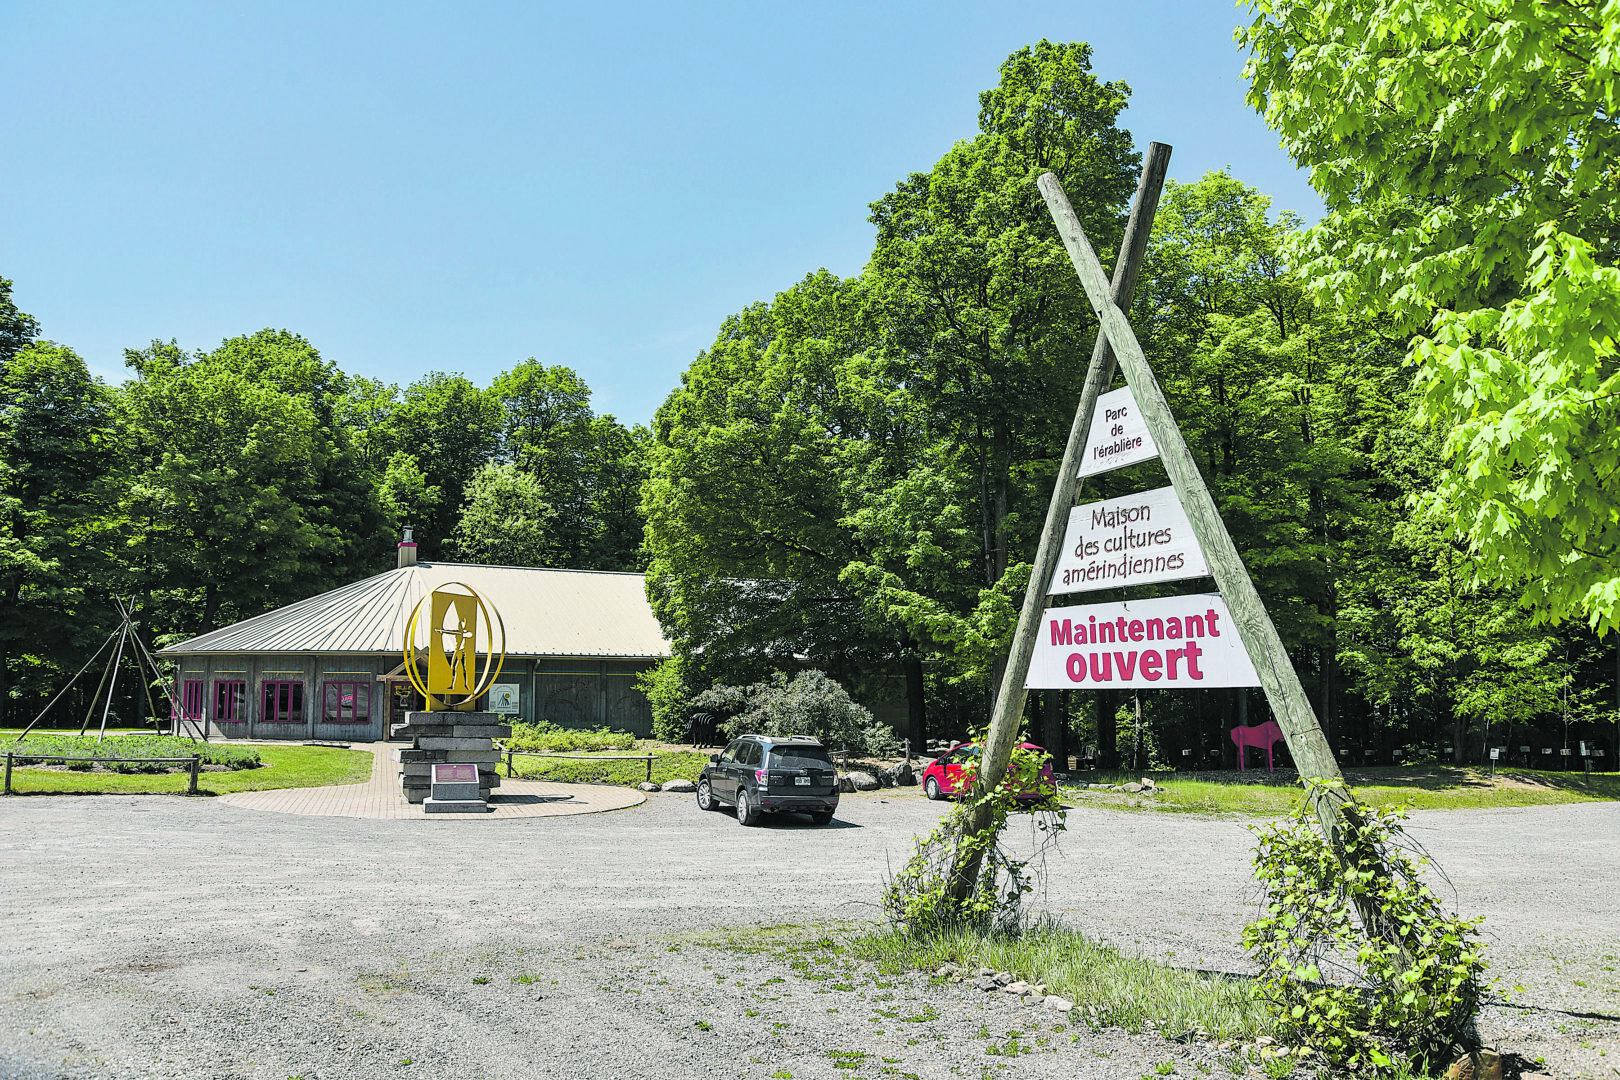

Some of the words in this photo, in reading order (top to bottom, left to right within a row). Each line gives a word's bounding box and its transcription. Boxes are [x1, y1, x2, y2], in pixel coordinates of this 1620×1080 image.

[1105, 406, 1128, 423] Parc
[1111, 423, 1124, 437] de
[1093, 436, 1142, 460] l'érablière
[1091, 505, 1151, 531] Maison
[1074, 536, 1100, 560] des
[1103, 525, 1172, 553] cultures
[1062, 552, 1185, 586] amérindiennes
[1050, 609, 1221, 646] Maintenant
[1066, 641, 1204, 683] ouvert
